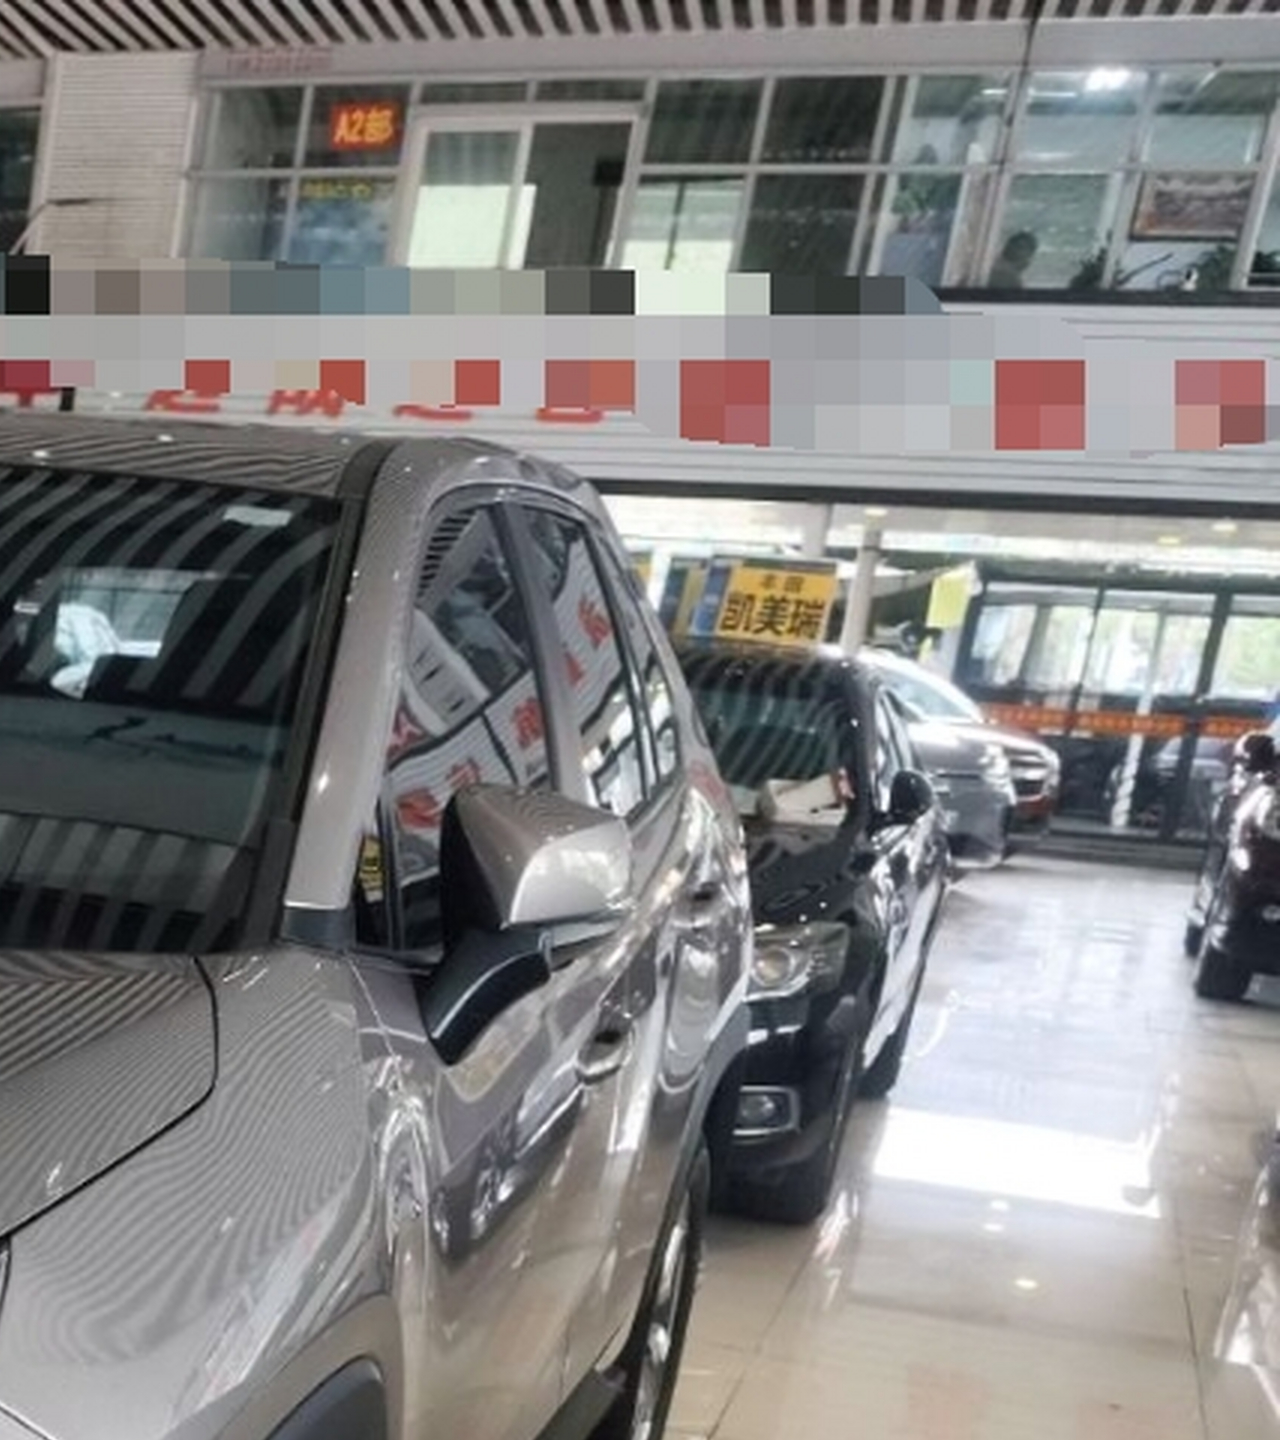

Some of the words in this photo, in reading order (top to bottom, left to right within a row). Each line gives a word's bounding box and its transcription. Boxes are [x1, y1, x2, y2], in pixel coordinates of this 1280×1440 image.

[334, 104, 394, 143] A2部
[718, 592, 825, 639] 凯美瑞
